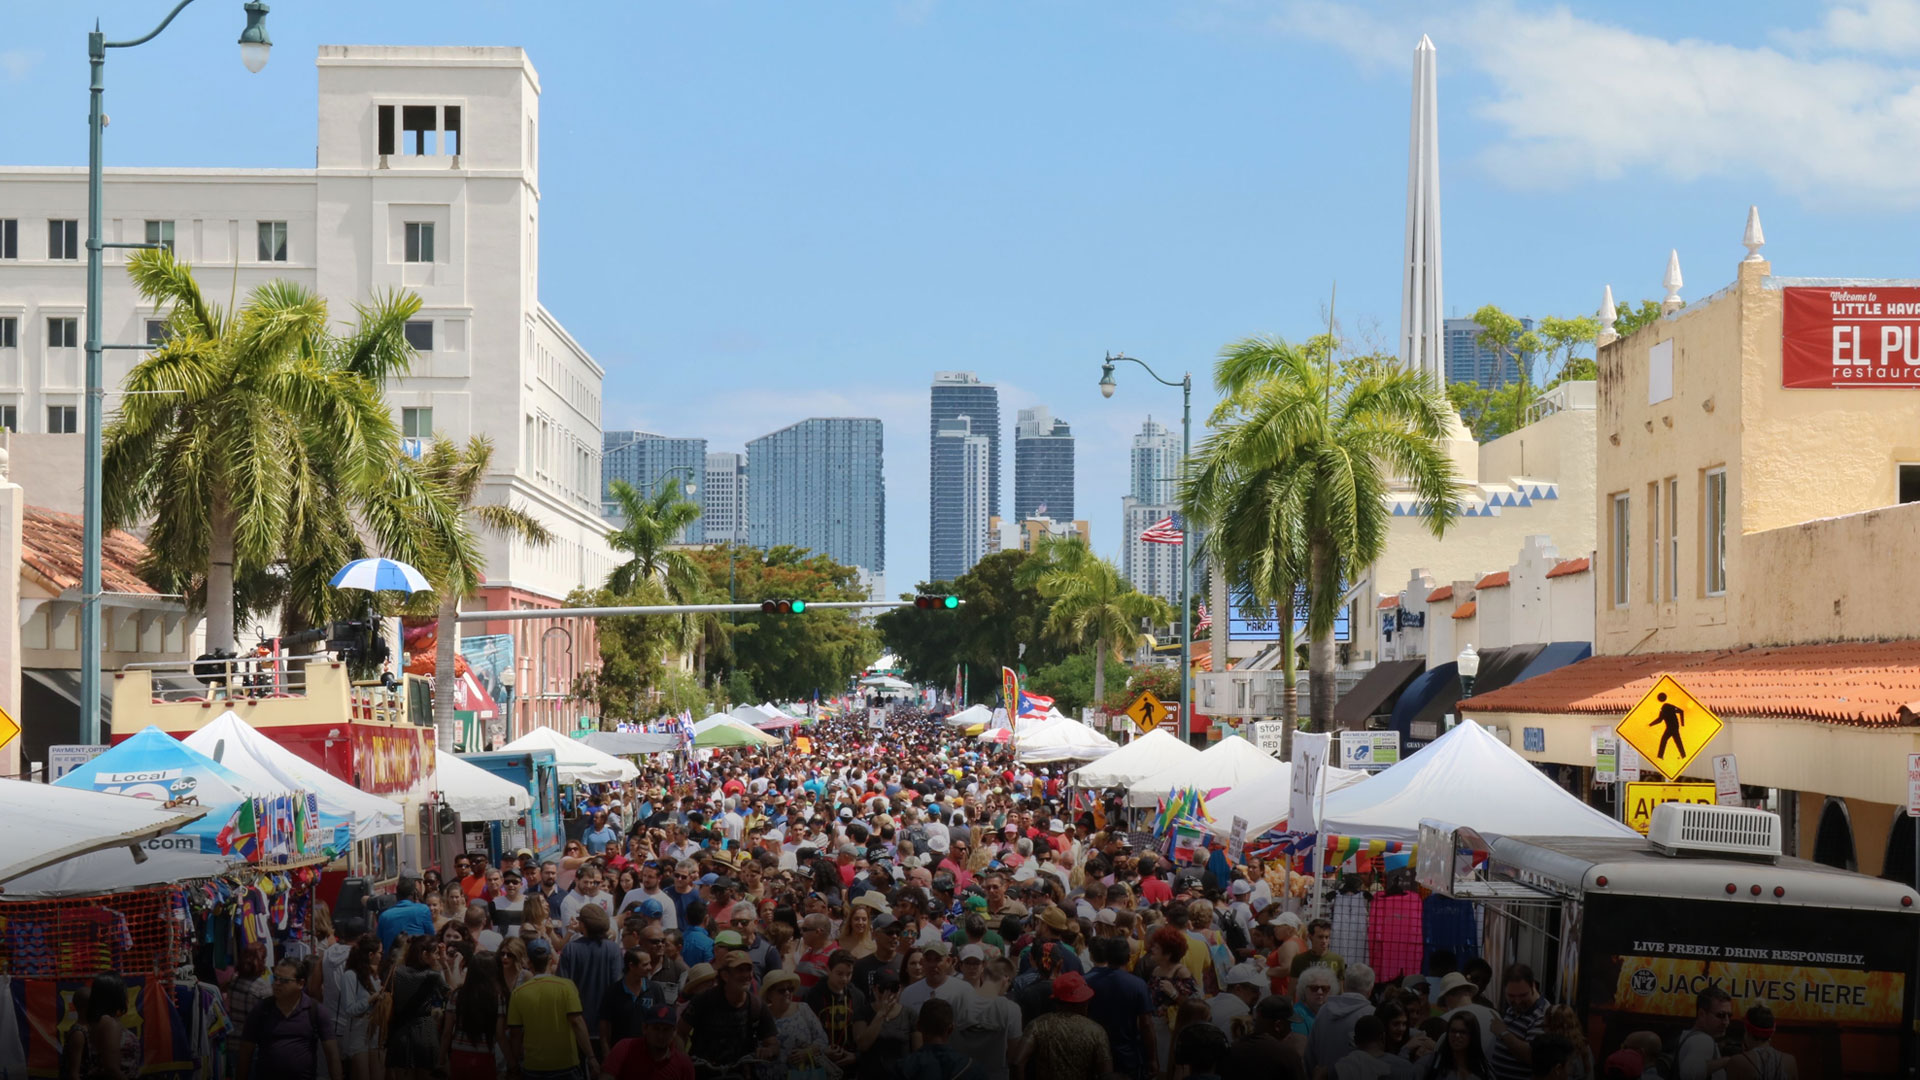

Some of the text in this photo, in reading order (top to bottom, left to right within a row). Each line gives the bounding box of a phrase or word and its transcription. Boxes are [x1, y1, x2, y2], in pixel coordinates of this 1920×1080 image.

[1830, 291, 1877, 302] Welcome to
[1833, 303, 1882, 315] LITTLE
[1833, 326, 1871, 366] EL
[1246, 622, 1273, 632] MARCH
[1259, 725, 1281, 734] STOP
[111, 771, 197, 792] Local abc
[1633, 940, 1865, 965] LIVE FREELY. DRINK RESPONSIBLY.
[1660, 973, 1867, 1006] JACK LIVES HERE
